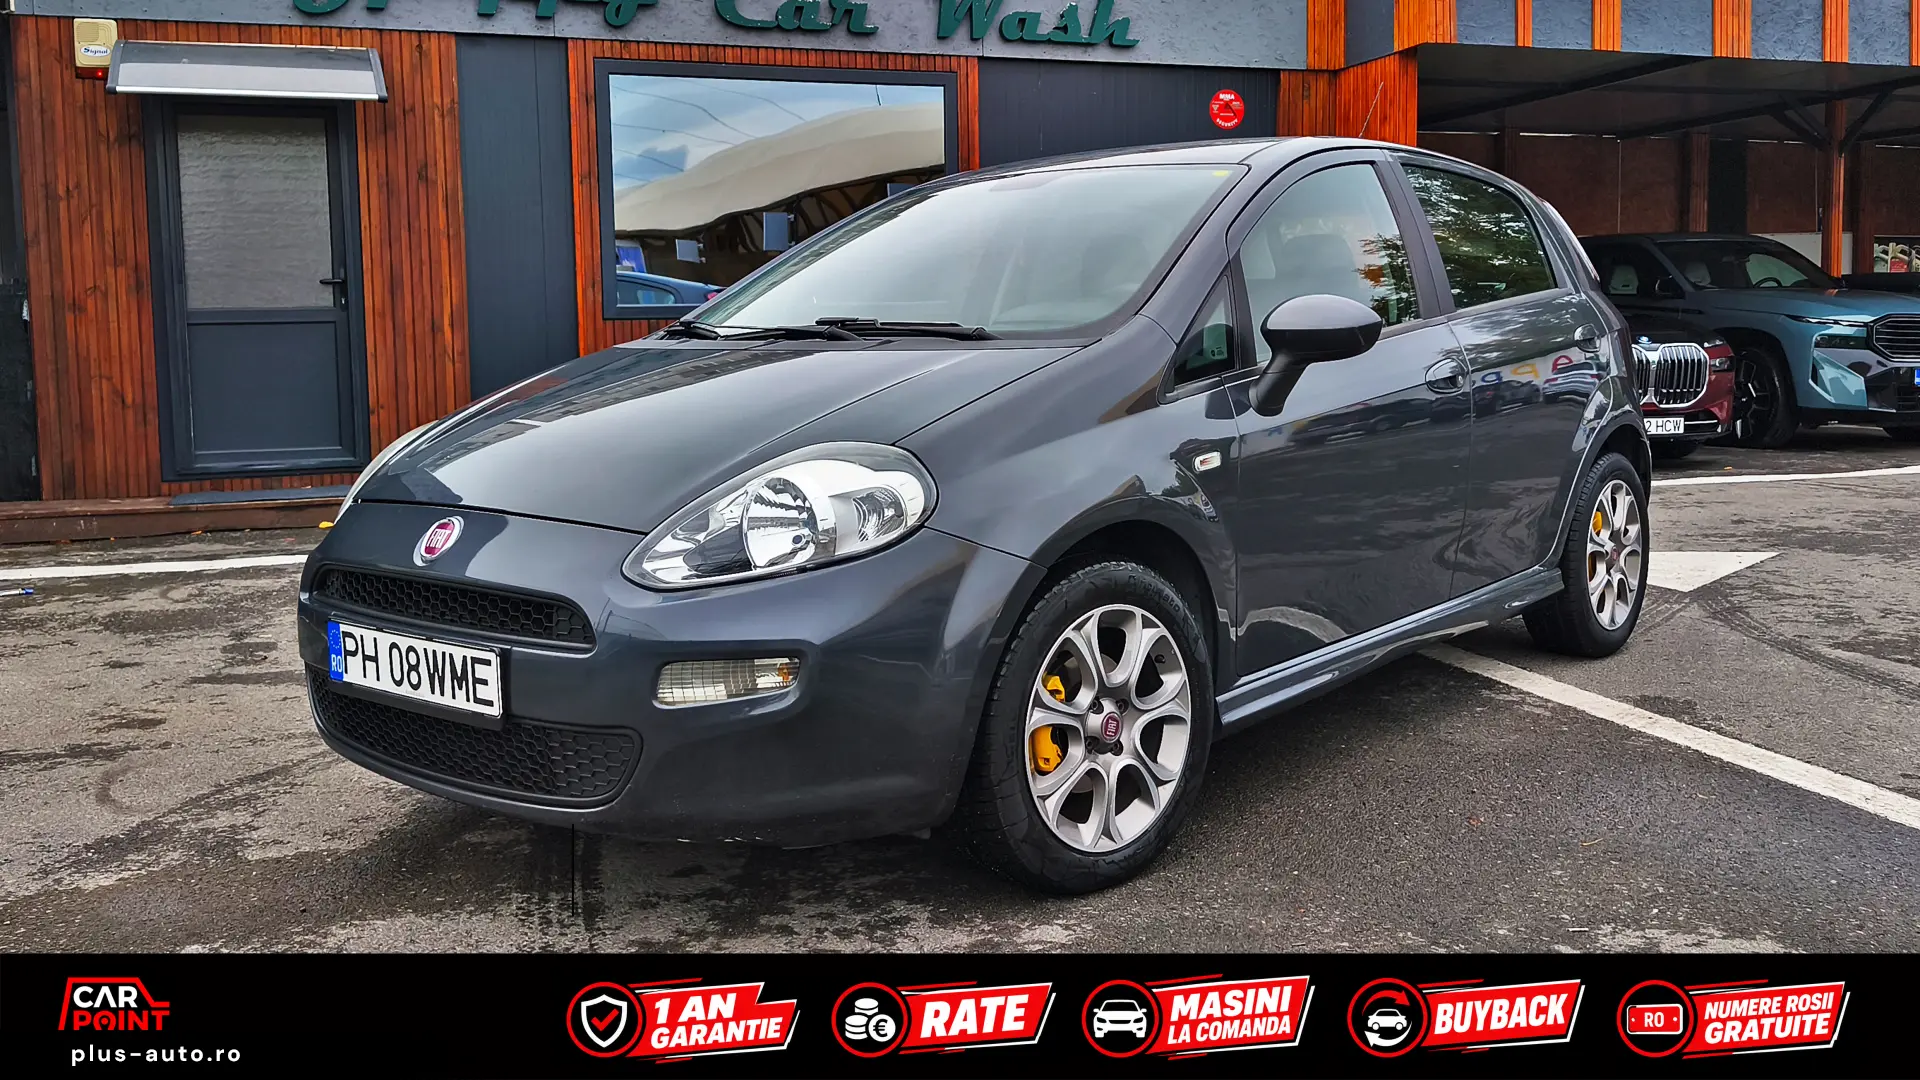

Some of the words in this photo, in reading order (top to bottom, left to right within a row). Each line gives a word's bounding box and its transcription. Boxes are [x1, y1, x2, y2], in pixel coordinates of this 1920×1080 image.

[936, 0, 1140, 47] Wash
[83, 47, 108, 55] Signal
[1656, 420, 1681, 432] HCW
[425, 527, 452, 549] FIAT
[331, 654, 343, 673] RO
[341, 630, 380, 682] PH
[388, 642, 494, 707] 08WME
[1106, 719, 1118, 736] FIAT
